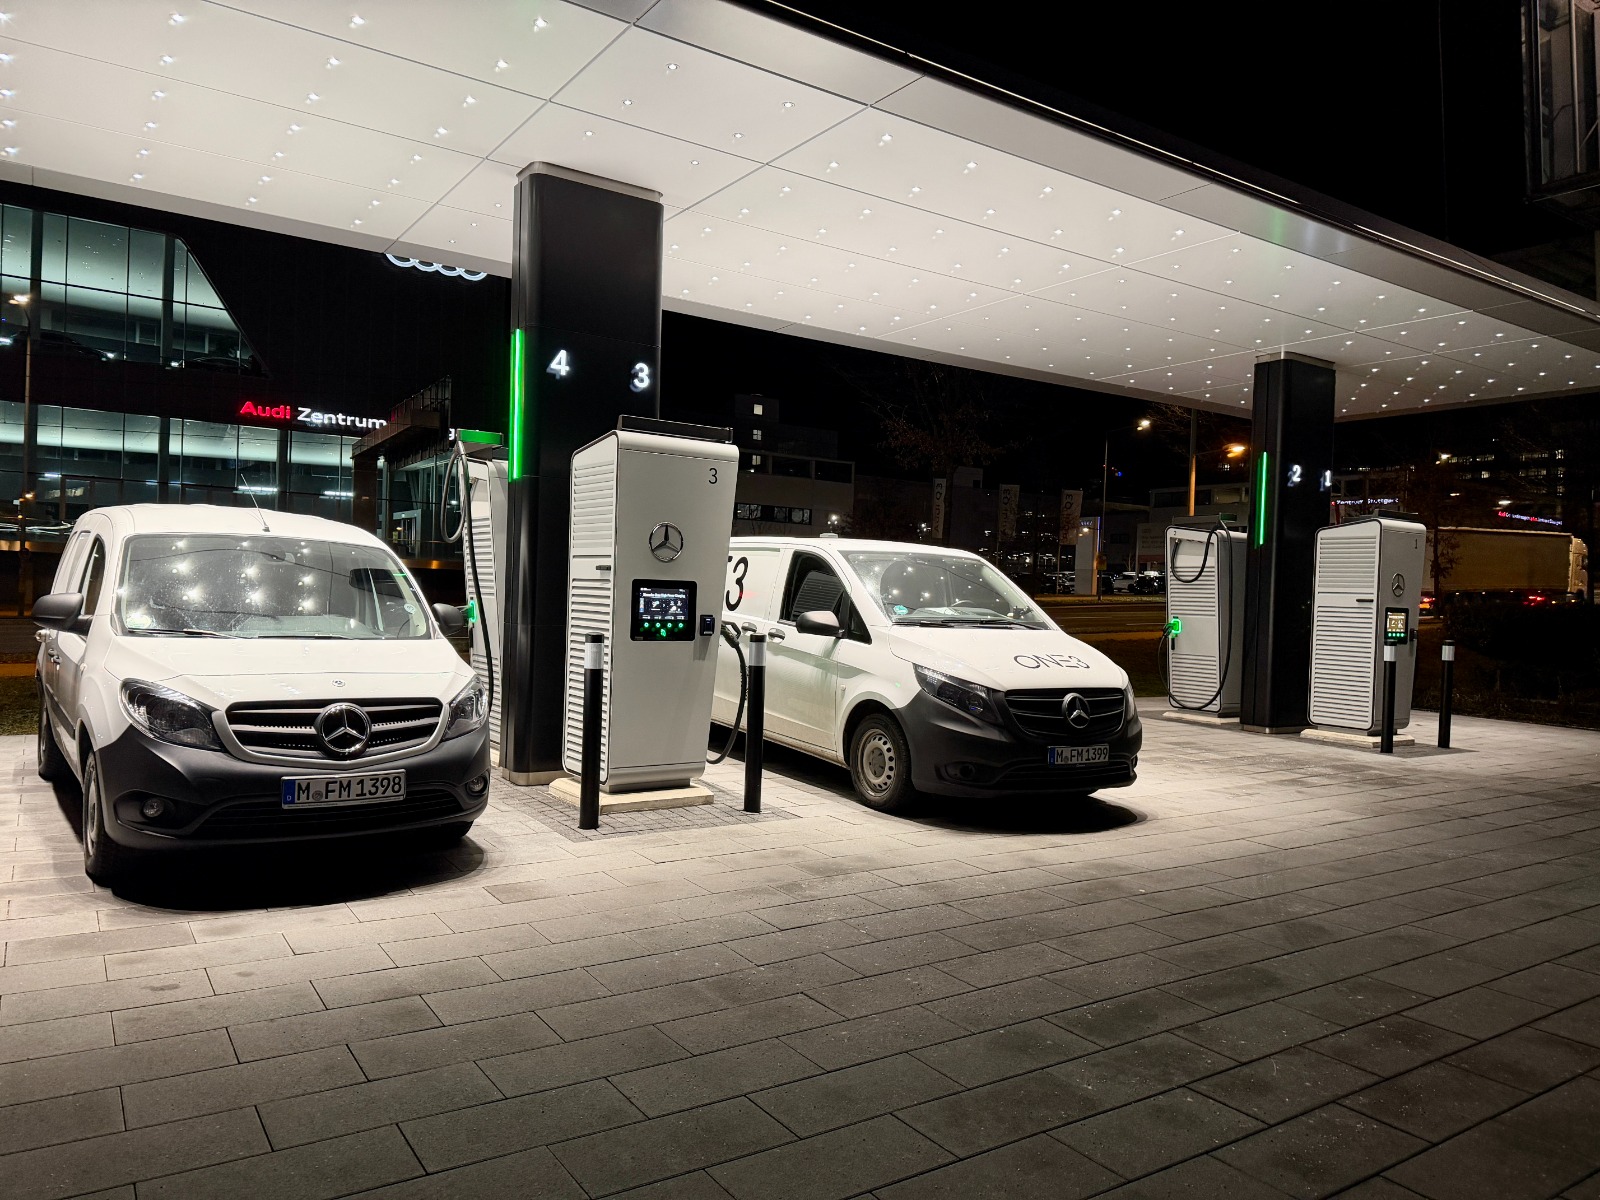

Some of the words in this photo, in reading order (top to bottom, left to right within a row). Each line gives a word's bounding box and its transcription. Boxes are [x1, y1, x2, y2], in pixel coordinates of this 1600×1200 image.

[547, 349, 570, 377] 4
[631, 362, 650, 390] 3
[239, 401, 291, 419] Audi
[297, 406, 387, 428] Zentrum
[708, 467, 718, 485] 3
[1290, 464, 1302, 484] 2
[1322, 469, 1332, 488] 1
[726, 555, 749, 612] 3
[1056, 750, 1064, 763] M
[1070, 748, 1084, 762] FM
[1085, 747, 1108, 761] 1399
[296, 782, 311, 801] M
[324, 780, 352, 800] FM
[355, 776, 402, 797] 1398
